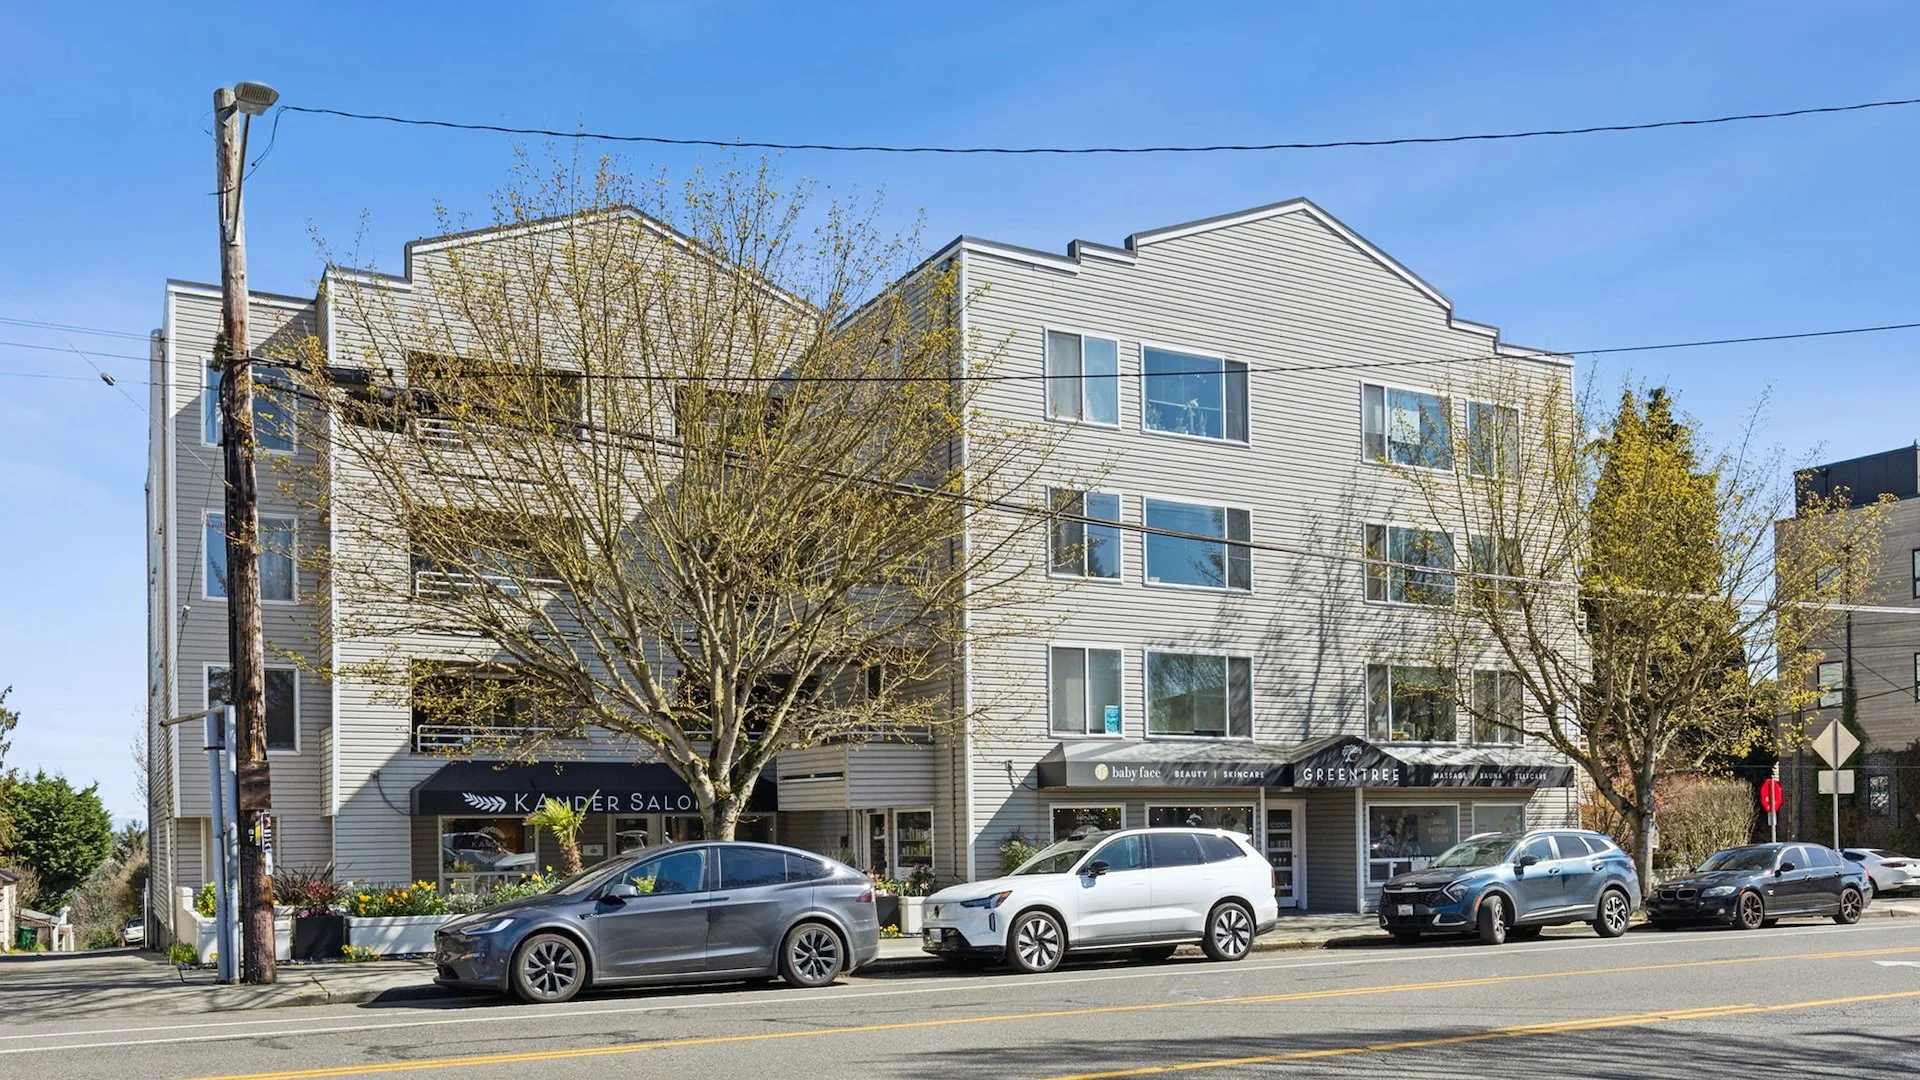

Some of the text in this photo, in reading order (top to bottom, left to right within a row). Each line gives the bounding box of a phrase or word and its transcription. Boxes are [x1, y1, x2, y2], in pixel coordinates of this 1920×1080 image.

[1112, 766, 1161, 781] baby face
[1174, 771, 1265, 779] BEAUTY SKINCARE
[1303, 768, 1399, 780] GREENTREE
[630, 793, 700, 811] SALO
